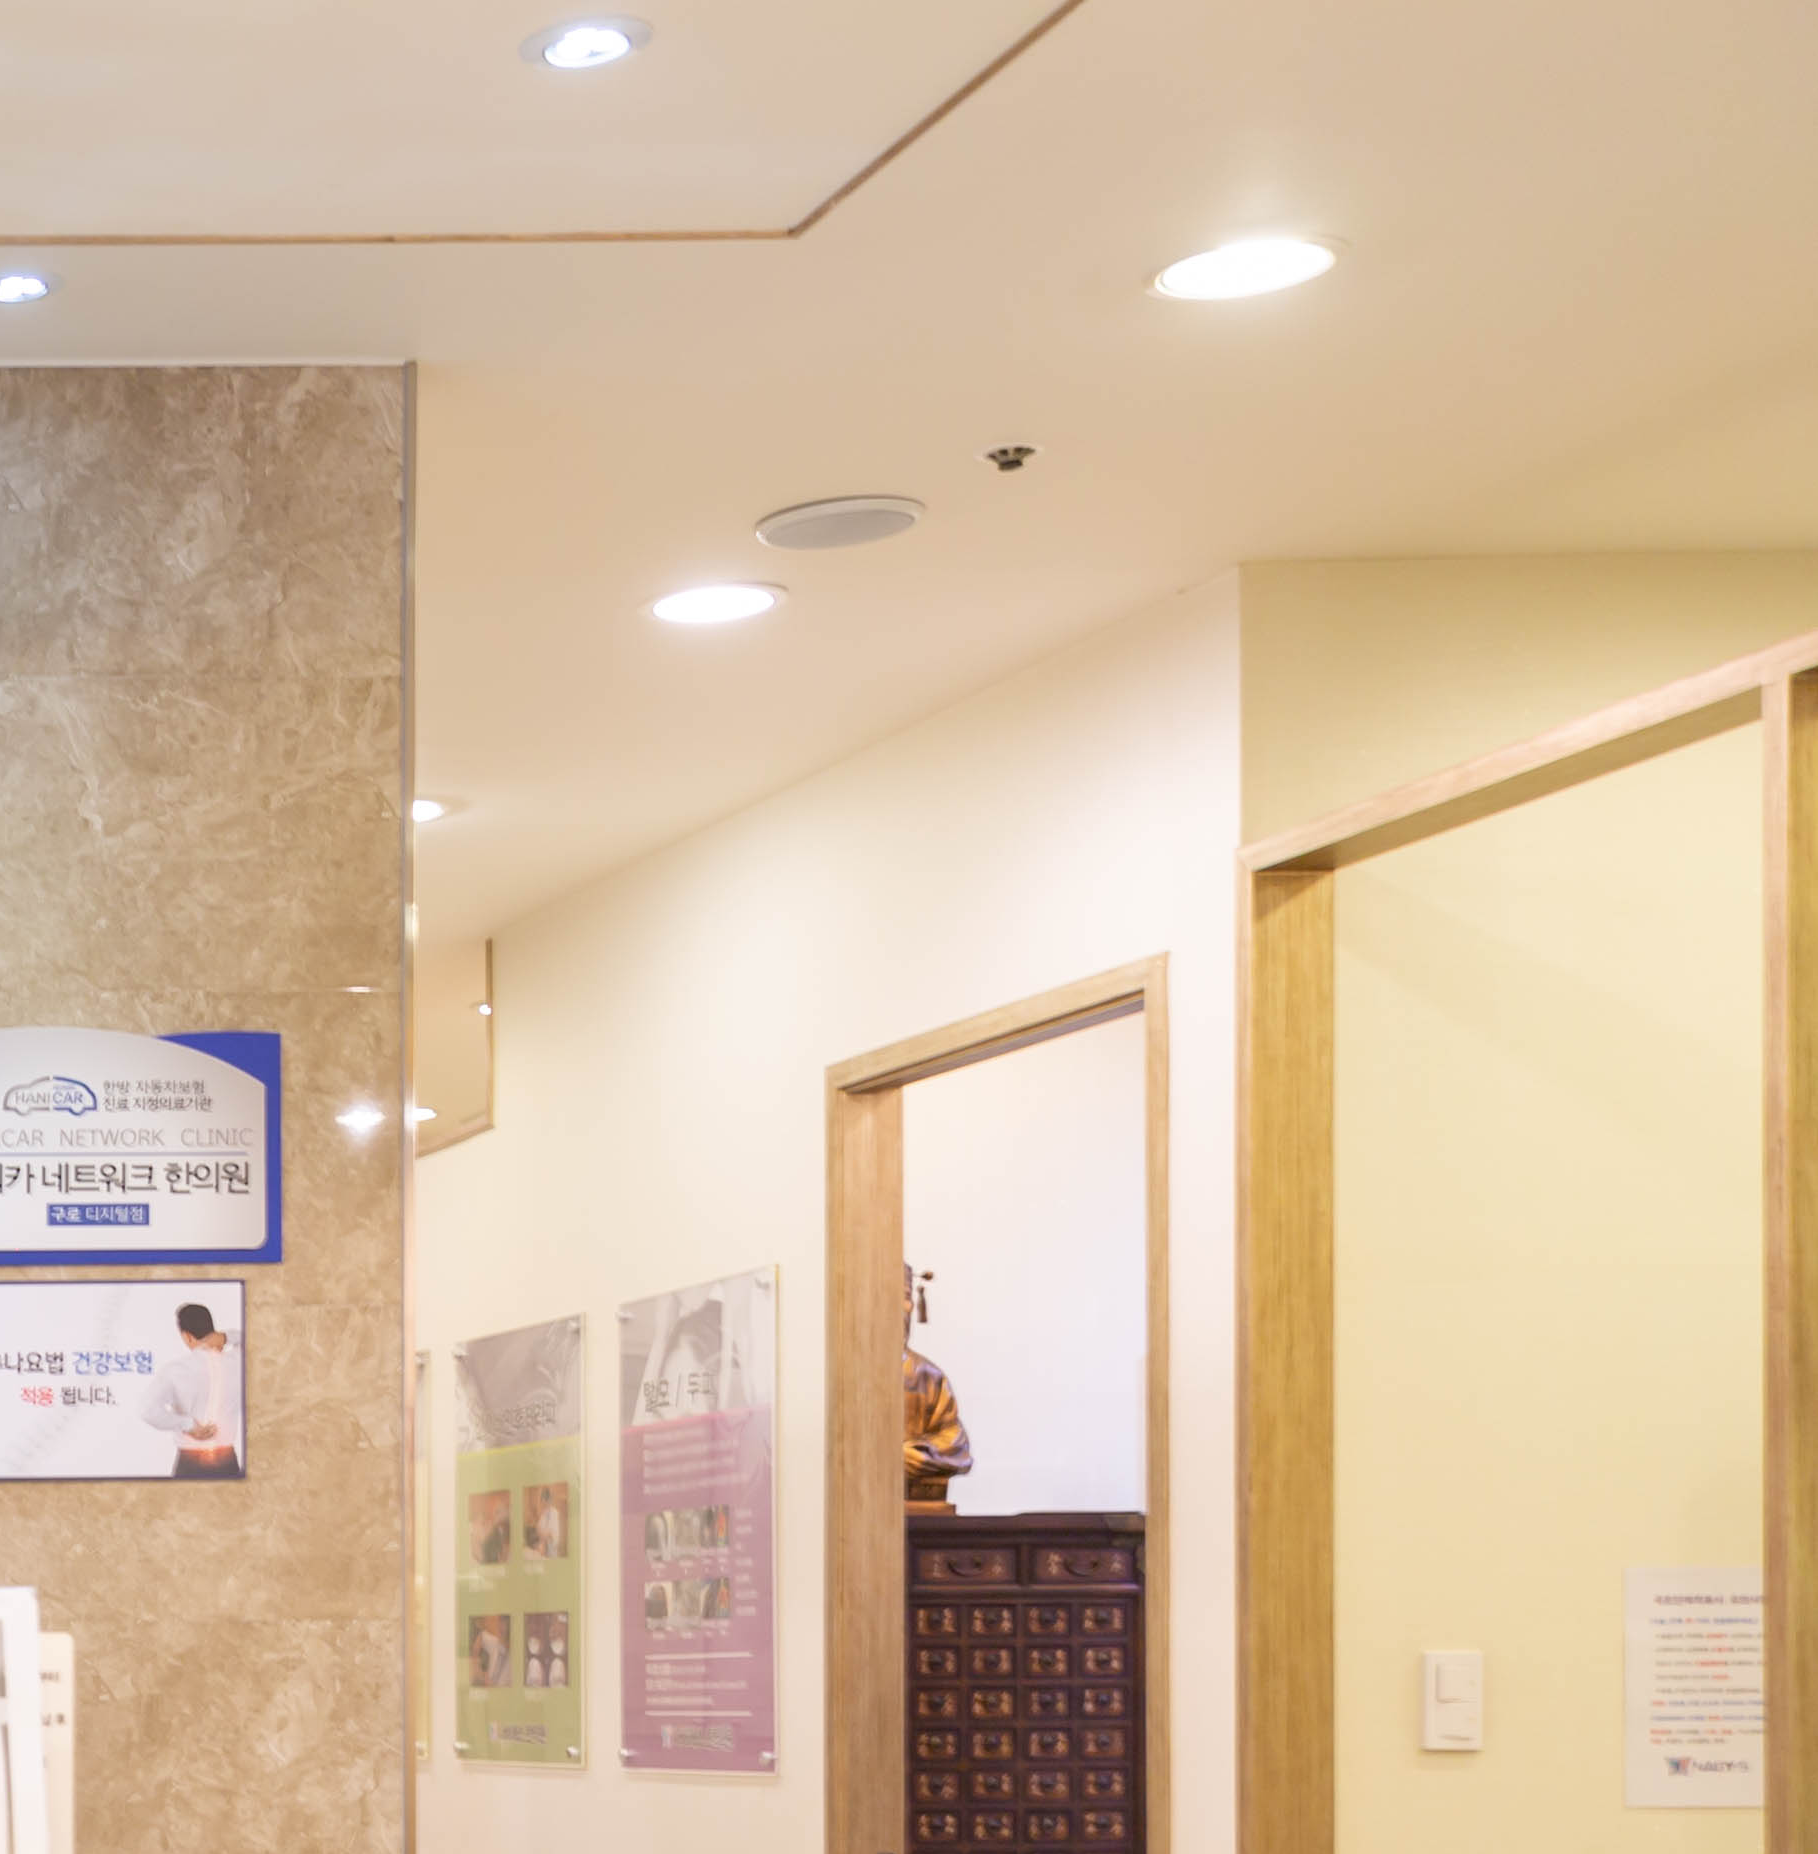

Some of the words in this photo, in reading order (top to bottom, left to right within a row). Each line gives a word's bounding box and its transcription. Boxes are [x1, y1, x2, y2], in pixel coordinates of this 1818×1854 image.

[103, 1080, 130, 1096] 한방
[135, 1080, 206, 1096] 자동차보험
[102, 1097, 131, 1112] 진료
[132, 1097, 214, 1112] 지정의료기관
[59, 1127, 166, 1148] NETWORK
[180, 1127, 254, 1148] CLINIC
[41, 1162, 158, 1195] 네트워크
[164, 1161, 251, 1195] 한의원
[51, 1207, 83, 1223] 구로
[85, 1207, 145, 1223] 디지털점
[72, 1351, 154, 1376] 건강보험
[21, 1386, 54, 1407] 적용
